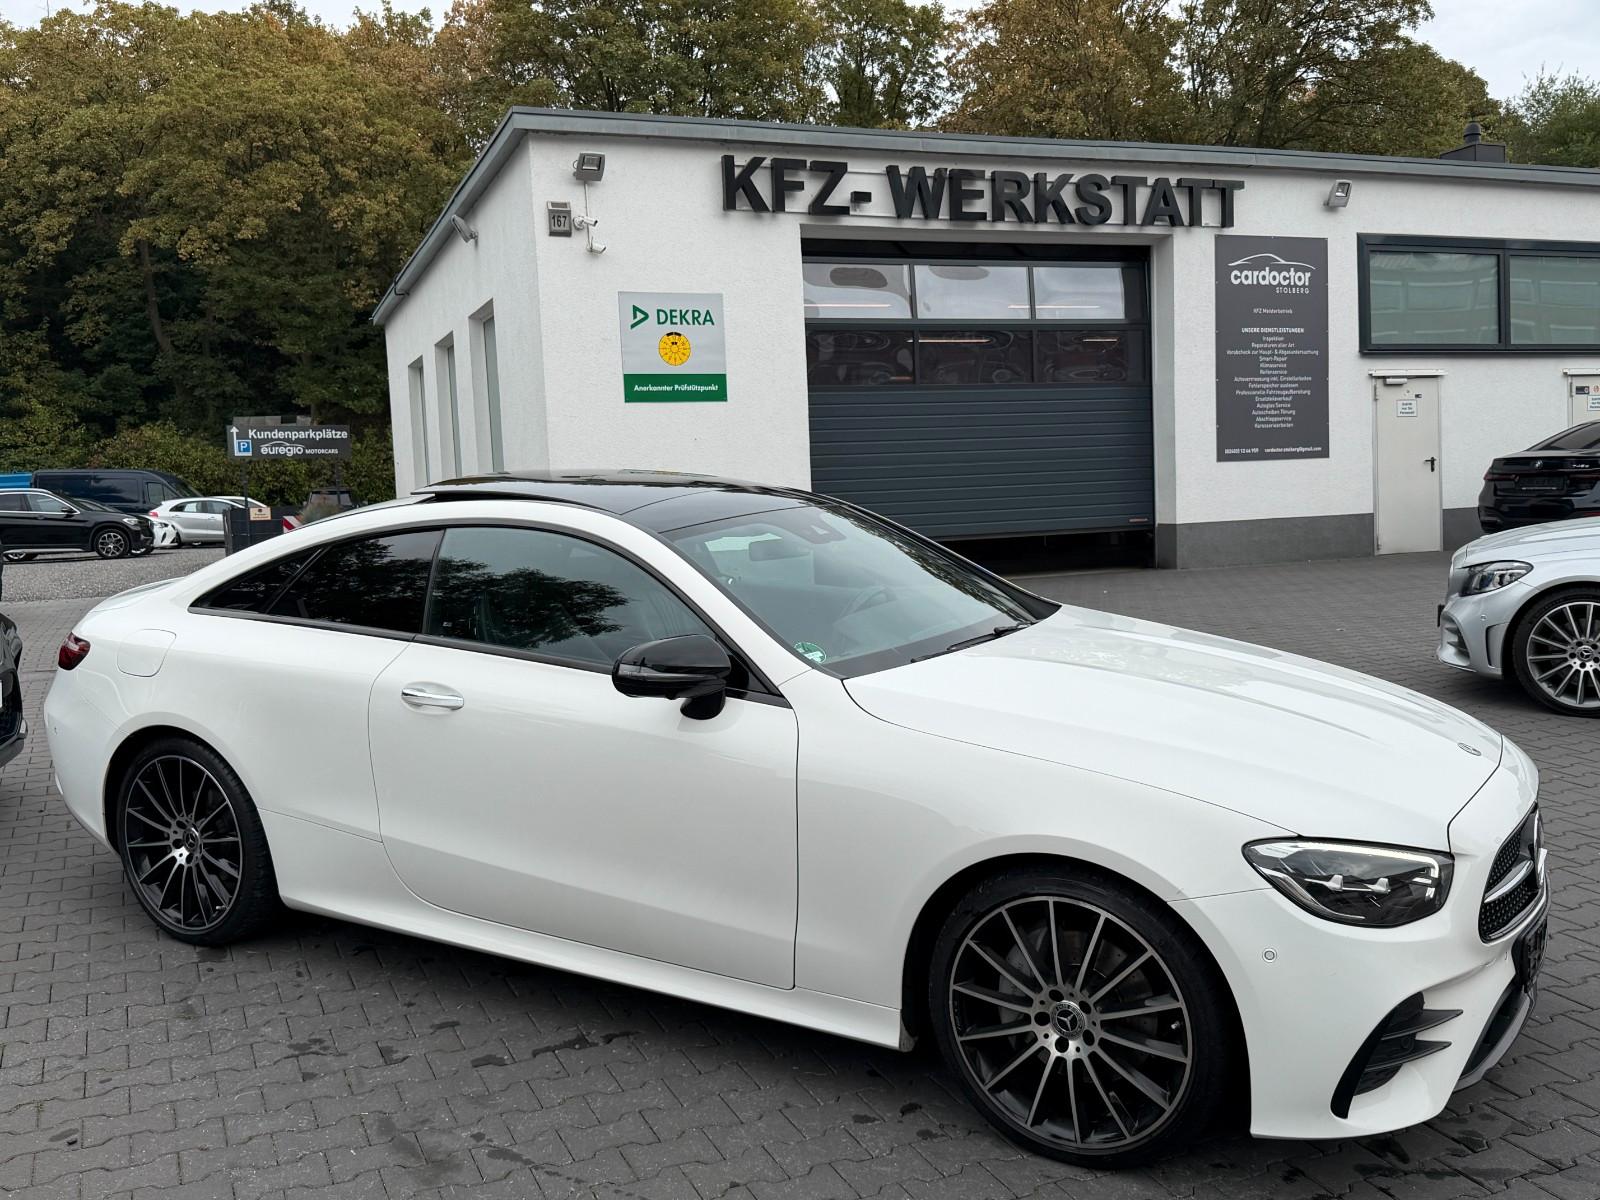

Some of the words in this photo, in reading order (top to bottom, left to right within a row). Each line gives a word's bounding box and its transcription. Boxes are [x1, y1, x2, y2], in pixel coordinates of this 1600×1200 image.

[552, 214, 567, 228] 167
[1230, 266, 1311, 286] cardoctor
[1275, 286, 1310, 294] STOLBERG
[656, 308, 715, 326] DEKRA
[633, 384, 674, 392] Anerkannter
[674, 383, 719, 393] Prüfstützpunkt
[248, 429, 348, 440] Kundenparkplätze
[240, 441, 248, 452] P
[260, 445, 304, 457] euregio
